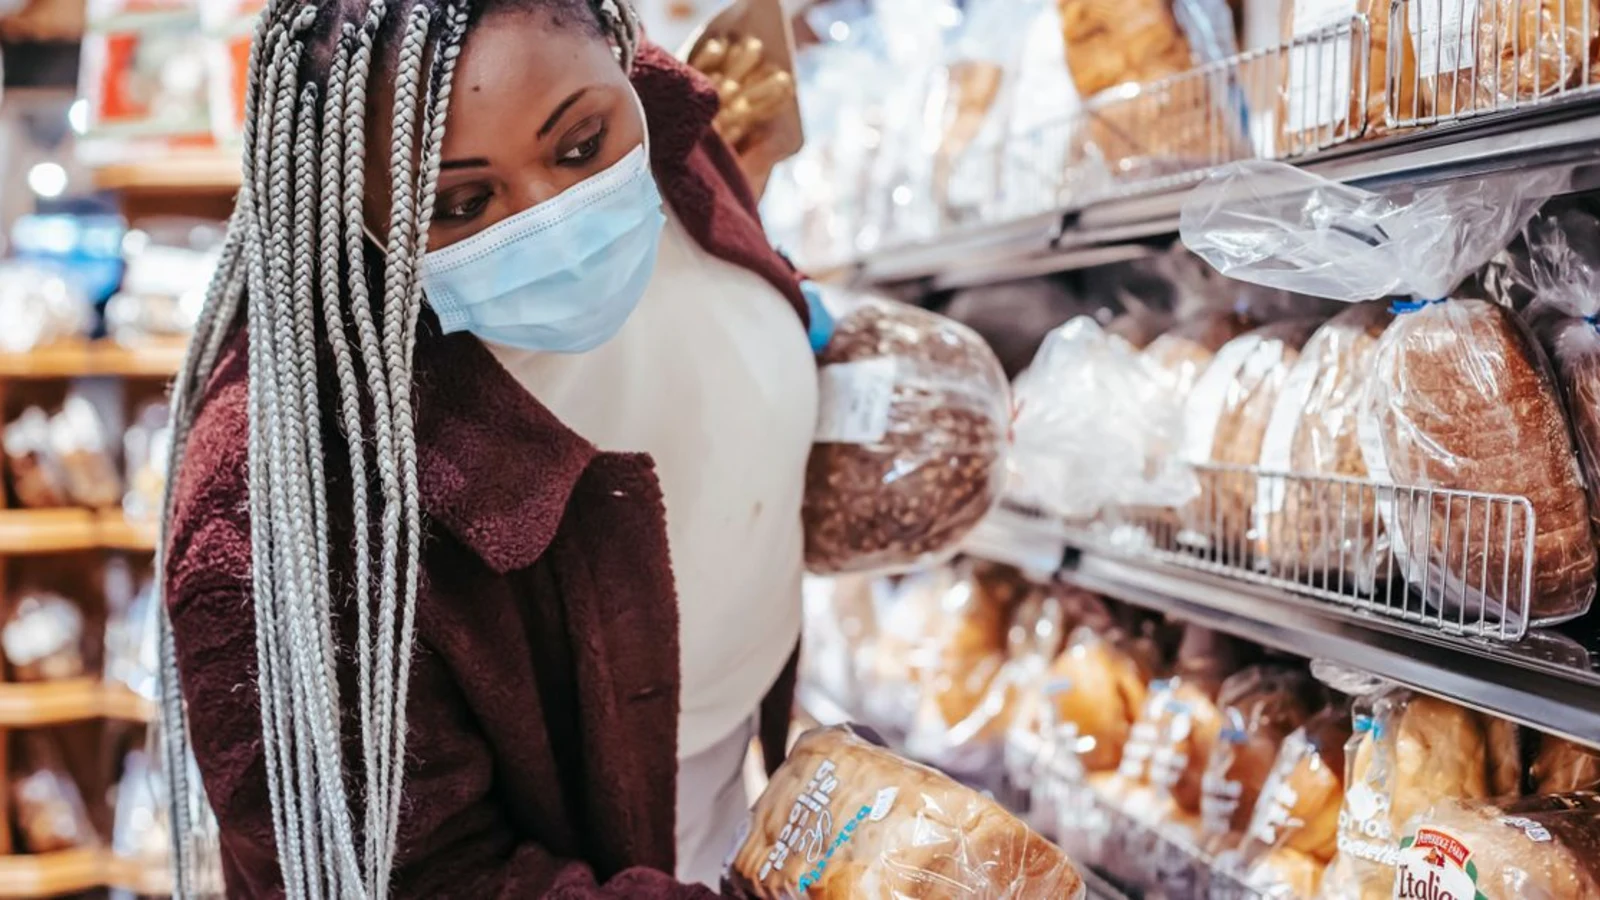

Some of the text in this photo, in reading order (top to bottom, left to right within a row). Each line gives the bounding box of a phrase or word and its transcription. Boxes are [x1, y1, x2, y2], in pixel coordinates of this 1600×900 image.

[759, 760, 836, 880] brioche
[773, 773, 839, 871] sliced
[1397, 864, 1458, 900] Itali
